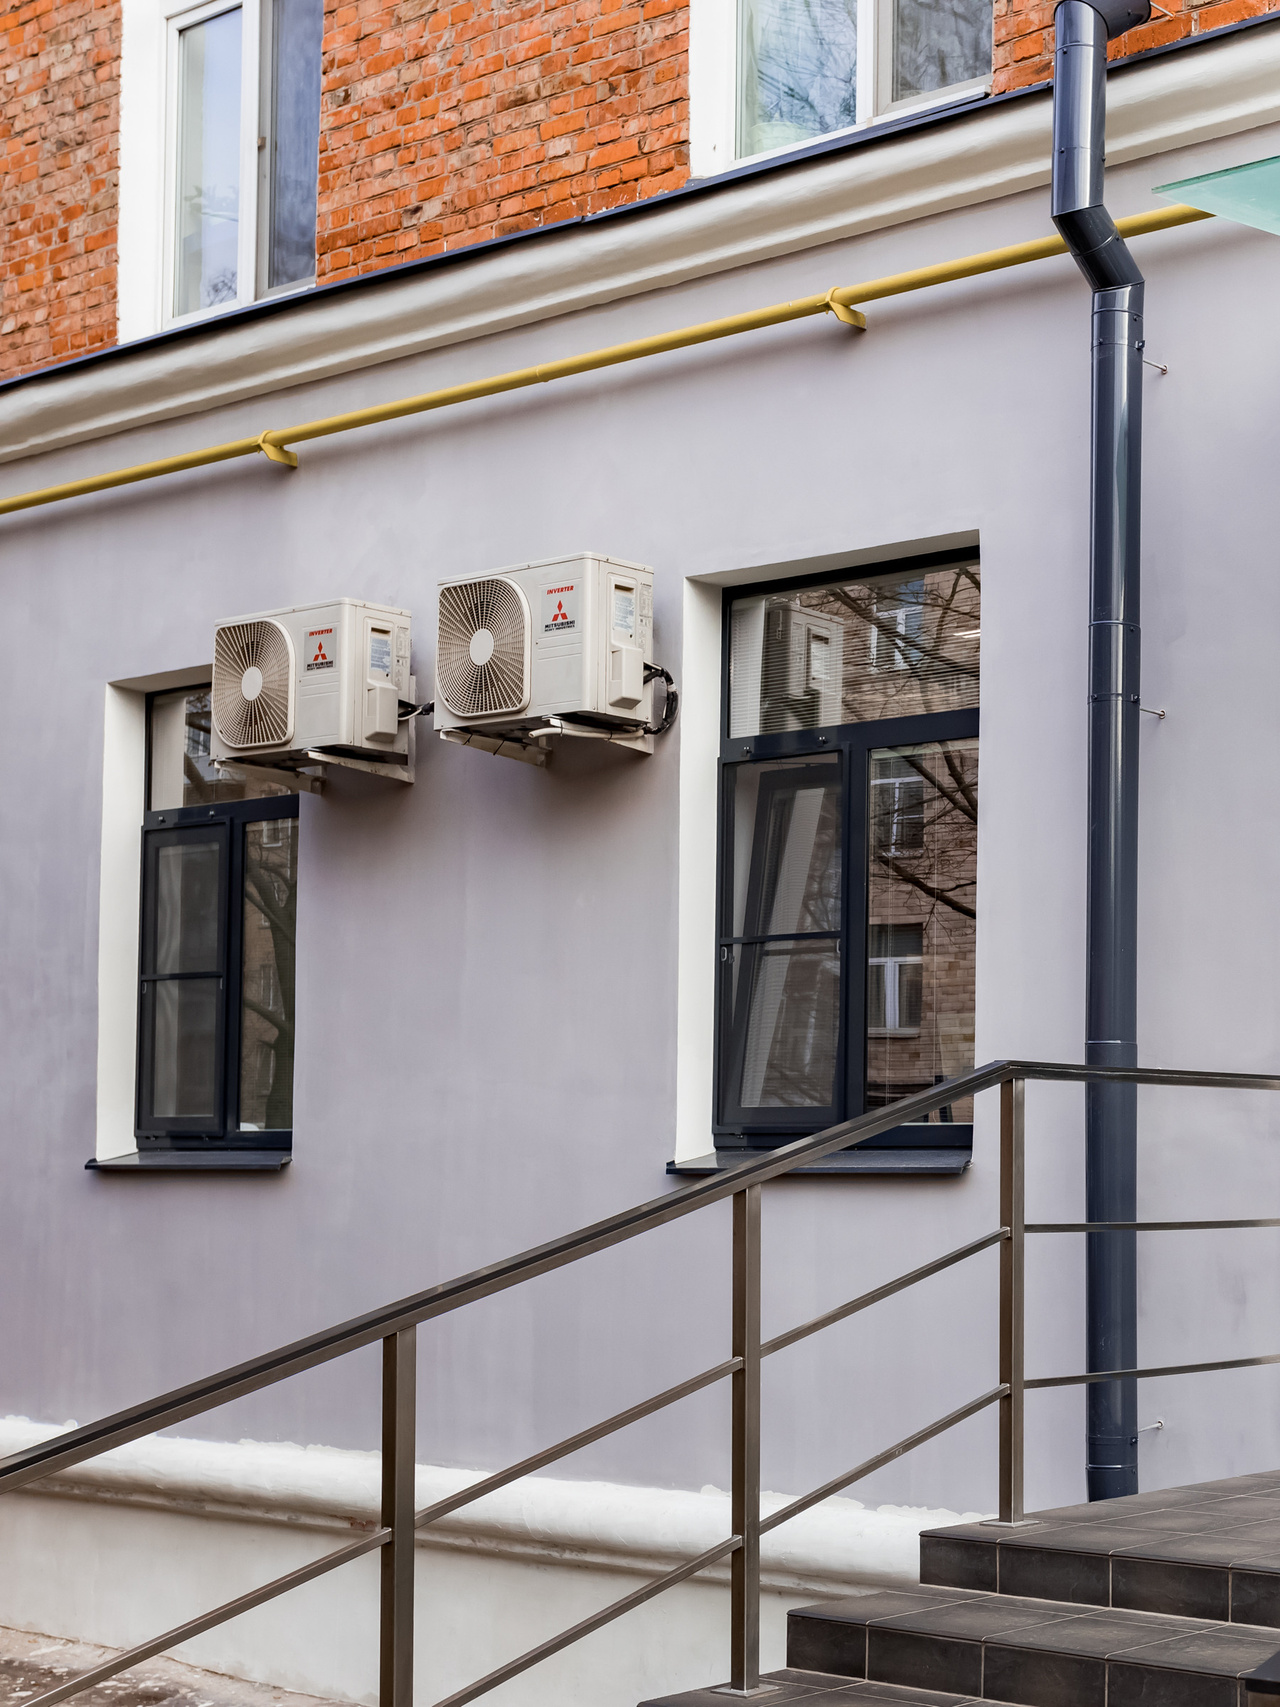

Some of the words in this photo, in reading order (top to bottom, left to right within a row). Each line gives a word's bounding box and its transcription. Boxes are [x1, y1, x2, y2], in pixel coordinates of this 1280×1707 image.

[546, 585, 574, 595] INVERTER
[544, 620, 576, 629] MITSUBISHI
[308, 628, 333, 637] INVERTER
[306, 660, 334, 668] MITSUBISHI
